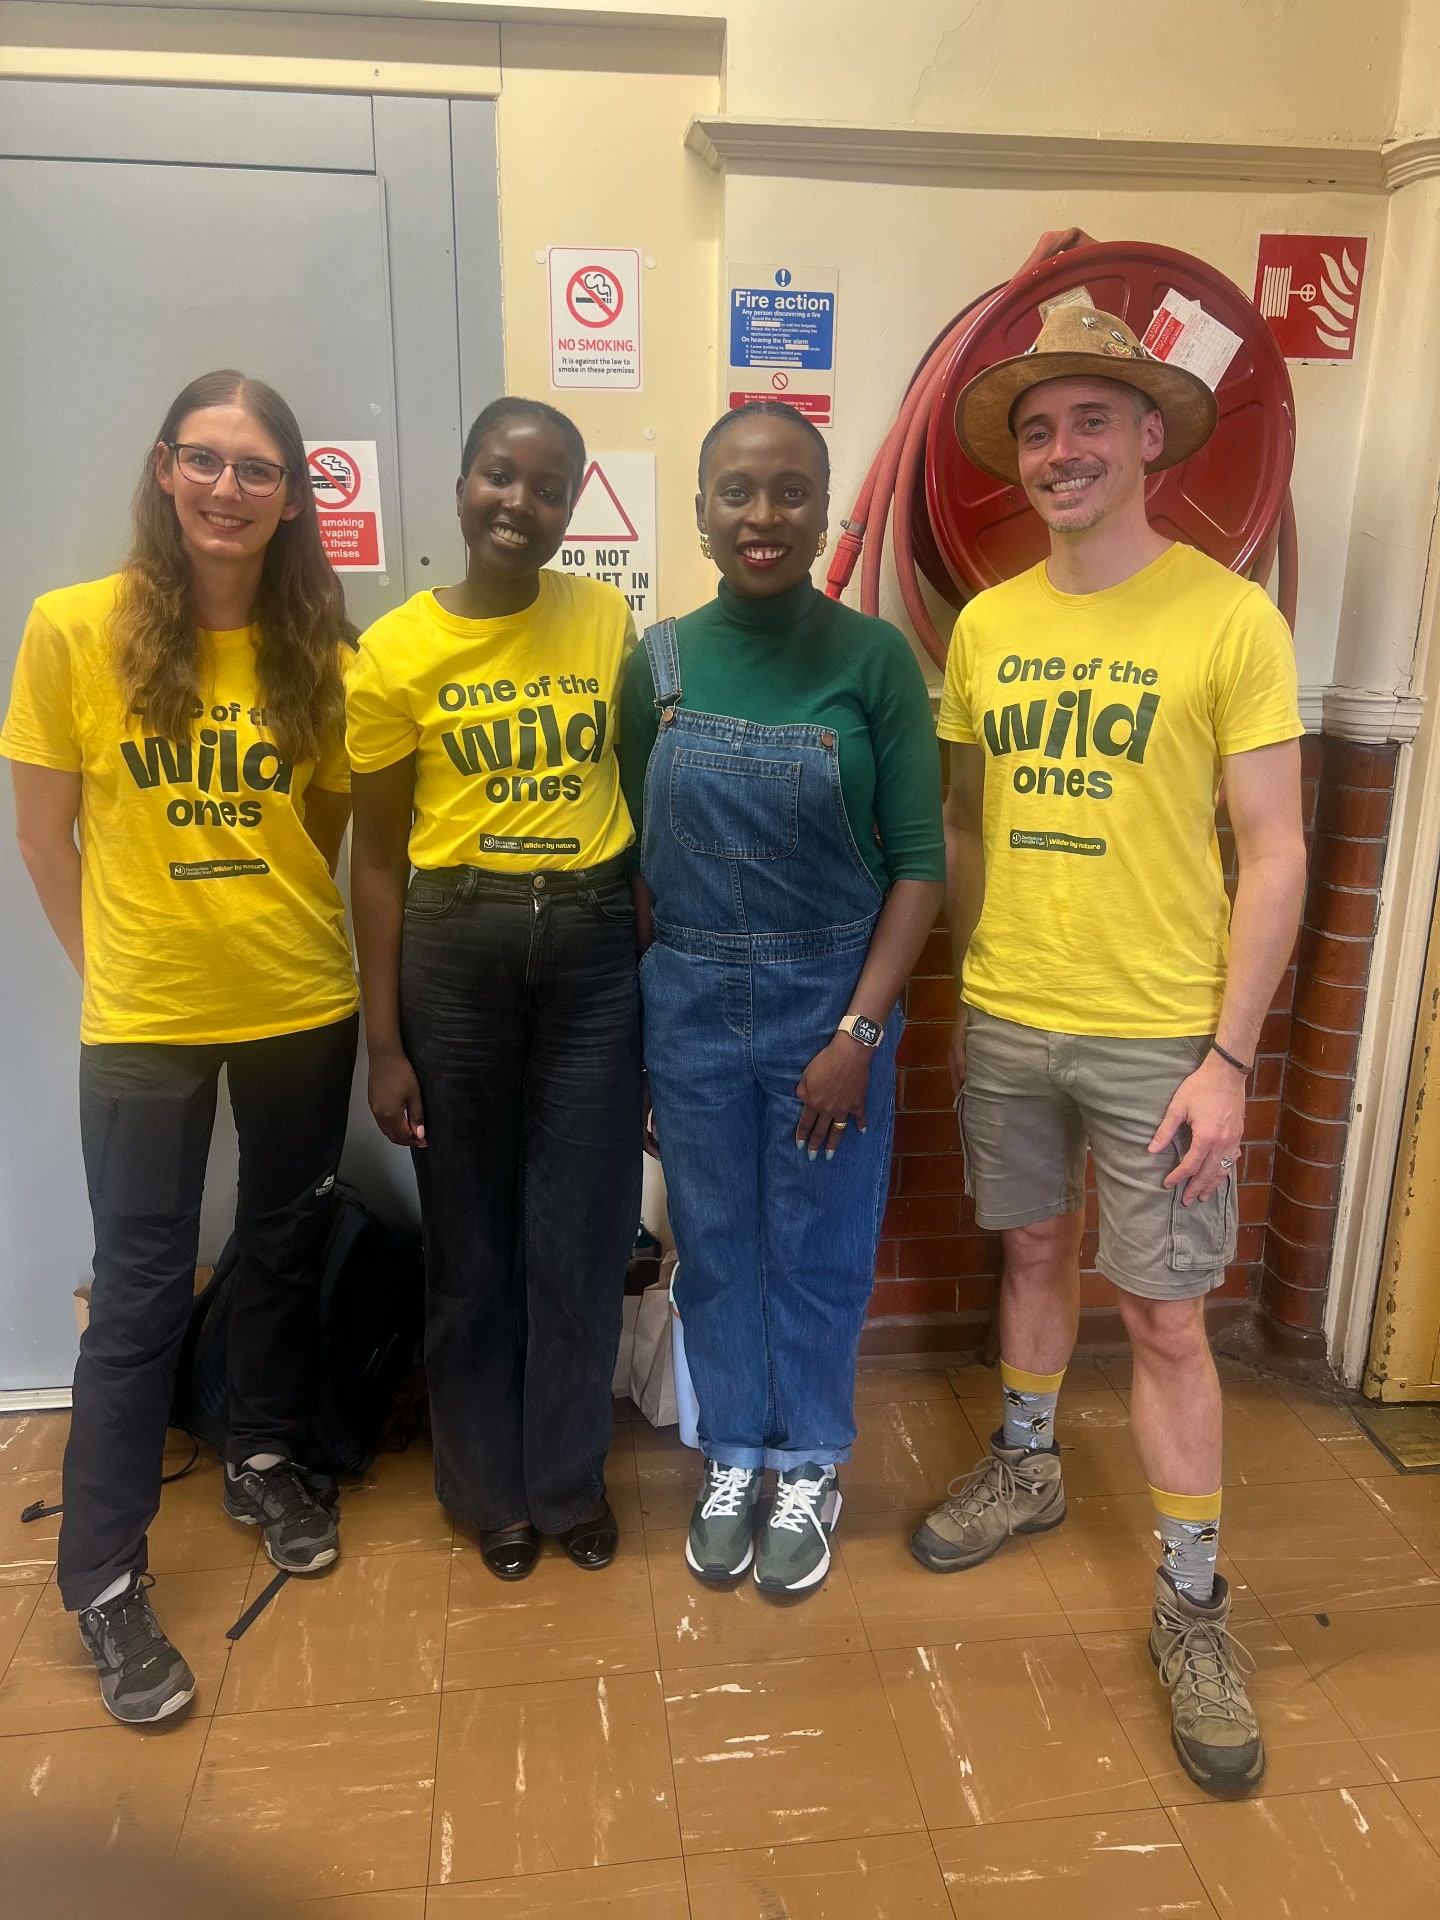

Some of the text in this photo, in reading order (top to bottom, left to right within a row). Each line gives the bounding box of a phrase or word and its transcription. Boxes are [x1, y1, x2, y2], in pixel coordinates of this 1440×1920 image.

[735, 291, 829, 311] Fire action
[558, 338, 636, 352] NO SMOKING.
[575, 357, 599, 366] against
[606, 367, 635, 375] premises
[322, 518, 364, 528] smoking
[326, 530, 359, 538] vaping
[330, 539, 358, 547] these
[326, 549, 360, 558] emises
[562, 550, 630, 566] DO NOT
[632, 573, 649, 589] IN
[997, 655, 1158, 686] One of the
[438, 674, 599, 711] One of the
[211, 702, 240, 722] of
[486, 775, 582, 803] ones
[1013, 766, 1113, 800] ones
[167, 799, 262, 827] ones
